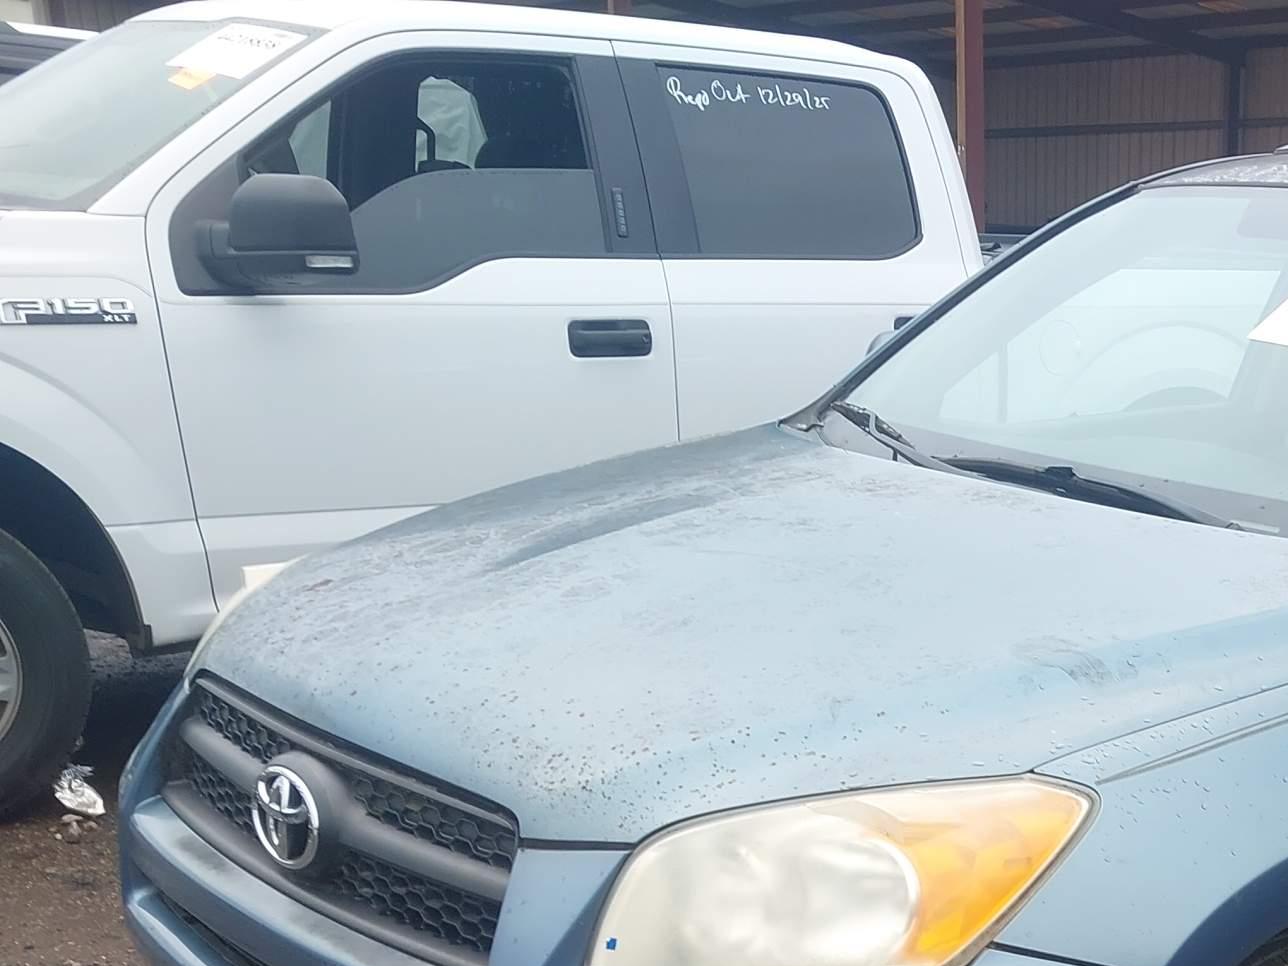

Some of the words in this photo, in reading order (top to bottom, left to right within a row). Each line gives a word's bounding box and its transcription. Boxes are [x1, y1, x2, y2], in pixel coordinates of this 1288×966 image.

[667, 76, 710, 111] Repo
[711, 79, 751, 103] Out
[757, 84, 831, 110] 12/29/25
[102, 313, 131, 322] XLT
